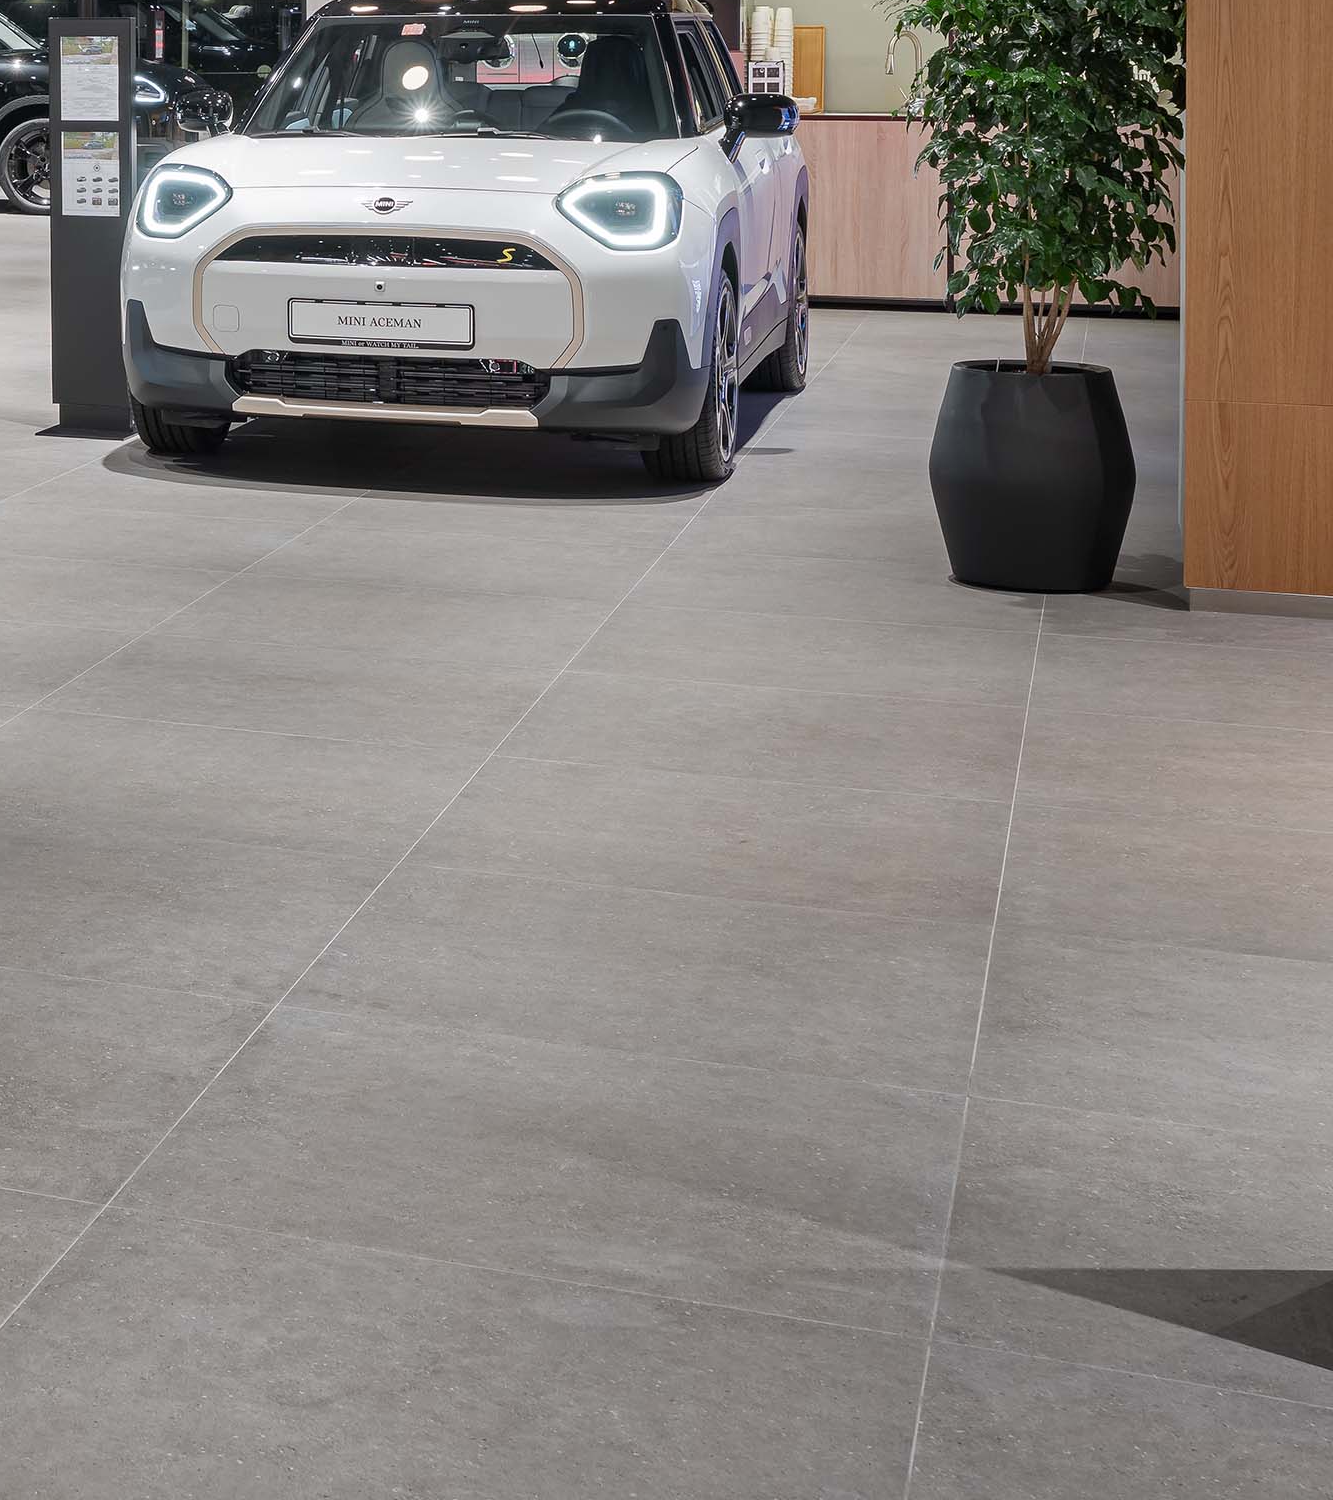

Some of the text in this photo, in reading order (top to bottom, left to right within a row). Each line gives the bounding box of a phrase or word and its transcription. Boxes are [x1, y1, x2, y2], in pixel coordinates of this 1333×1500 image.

[374, 200, 395, 208] MINI
[497, 248, 517, 264] S
[337, 315, 422, 329] MINI ACEMAN
[341, 339, 357, 347] MINI
[366, 340, 390, 348] WATCH
